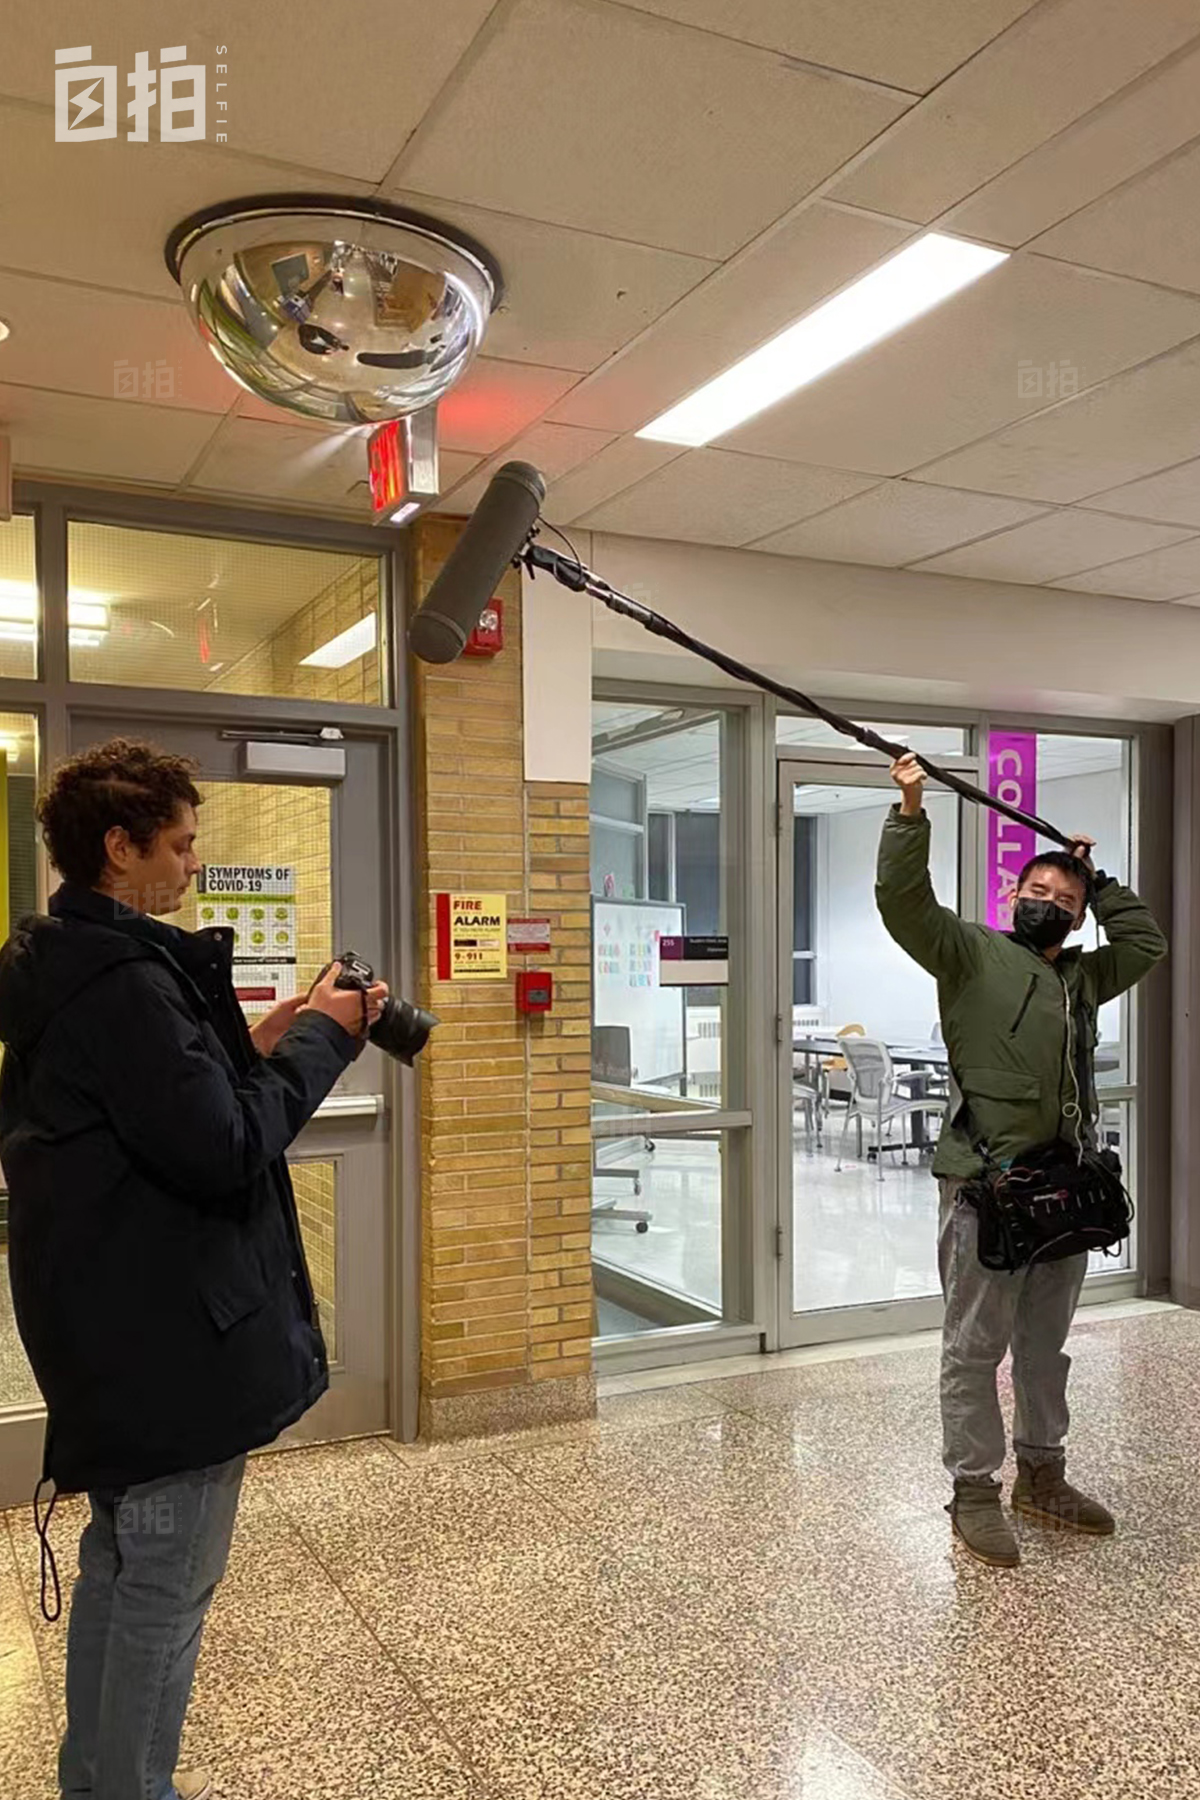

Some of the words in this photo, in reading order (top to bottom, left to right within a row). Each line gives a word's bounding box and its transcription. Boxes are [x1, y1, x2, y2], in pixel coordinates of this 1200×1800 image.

[208, 867, 272, 880] SYMPTOMS
[275, 868, 290, 880] OF
[208, 879, 262, 892] COVID-19
[453, 900, 482, 911] FIRE
[454, 916, 501, 926] ALARM
